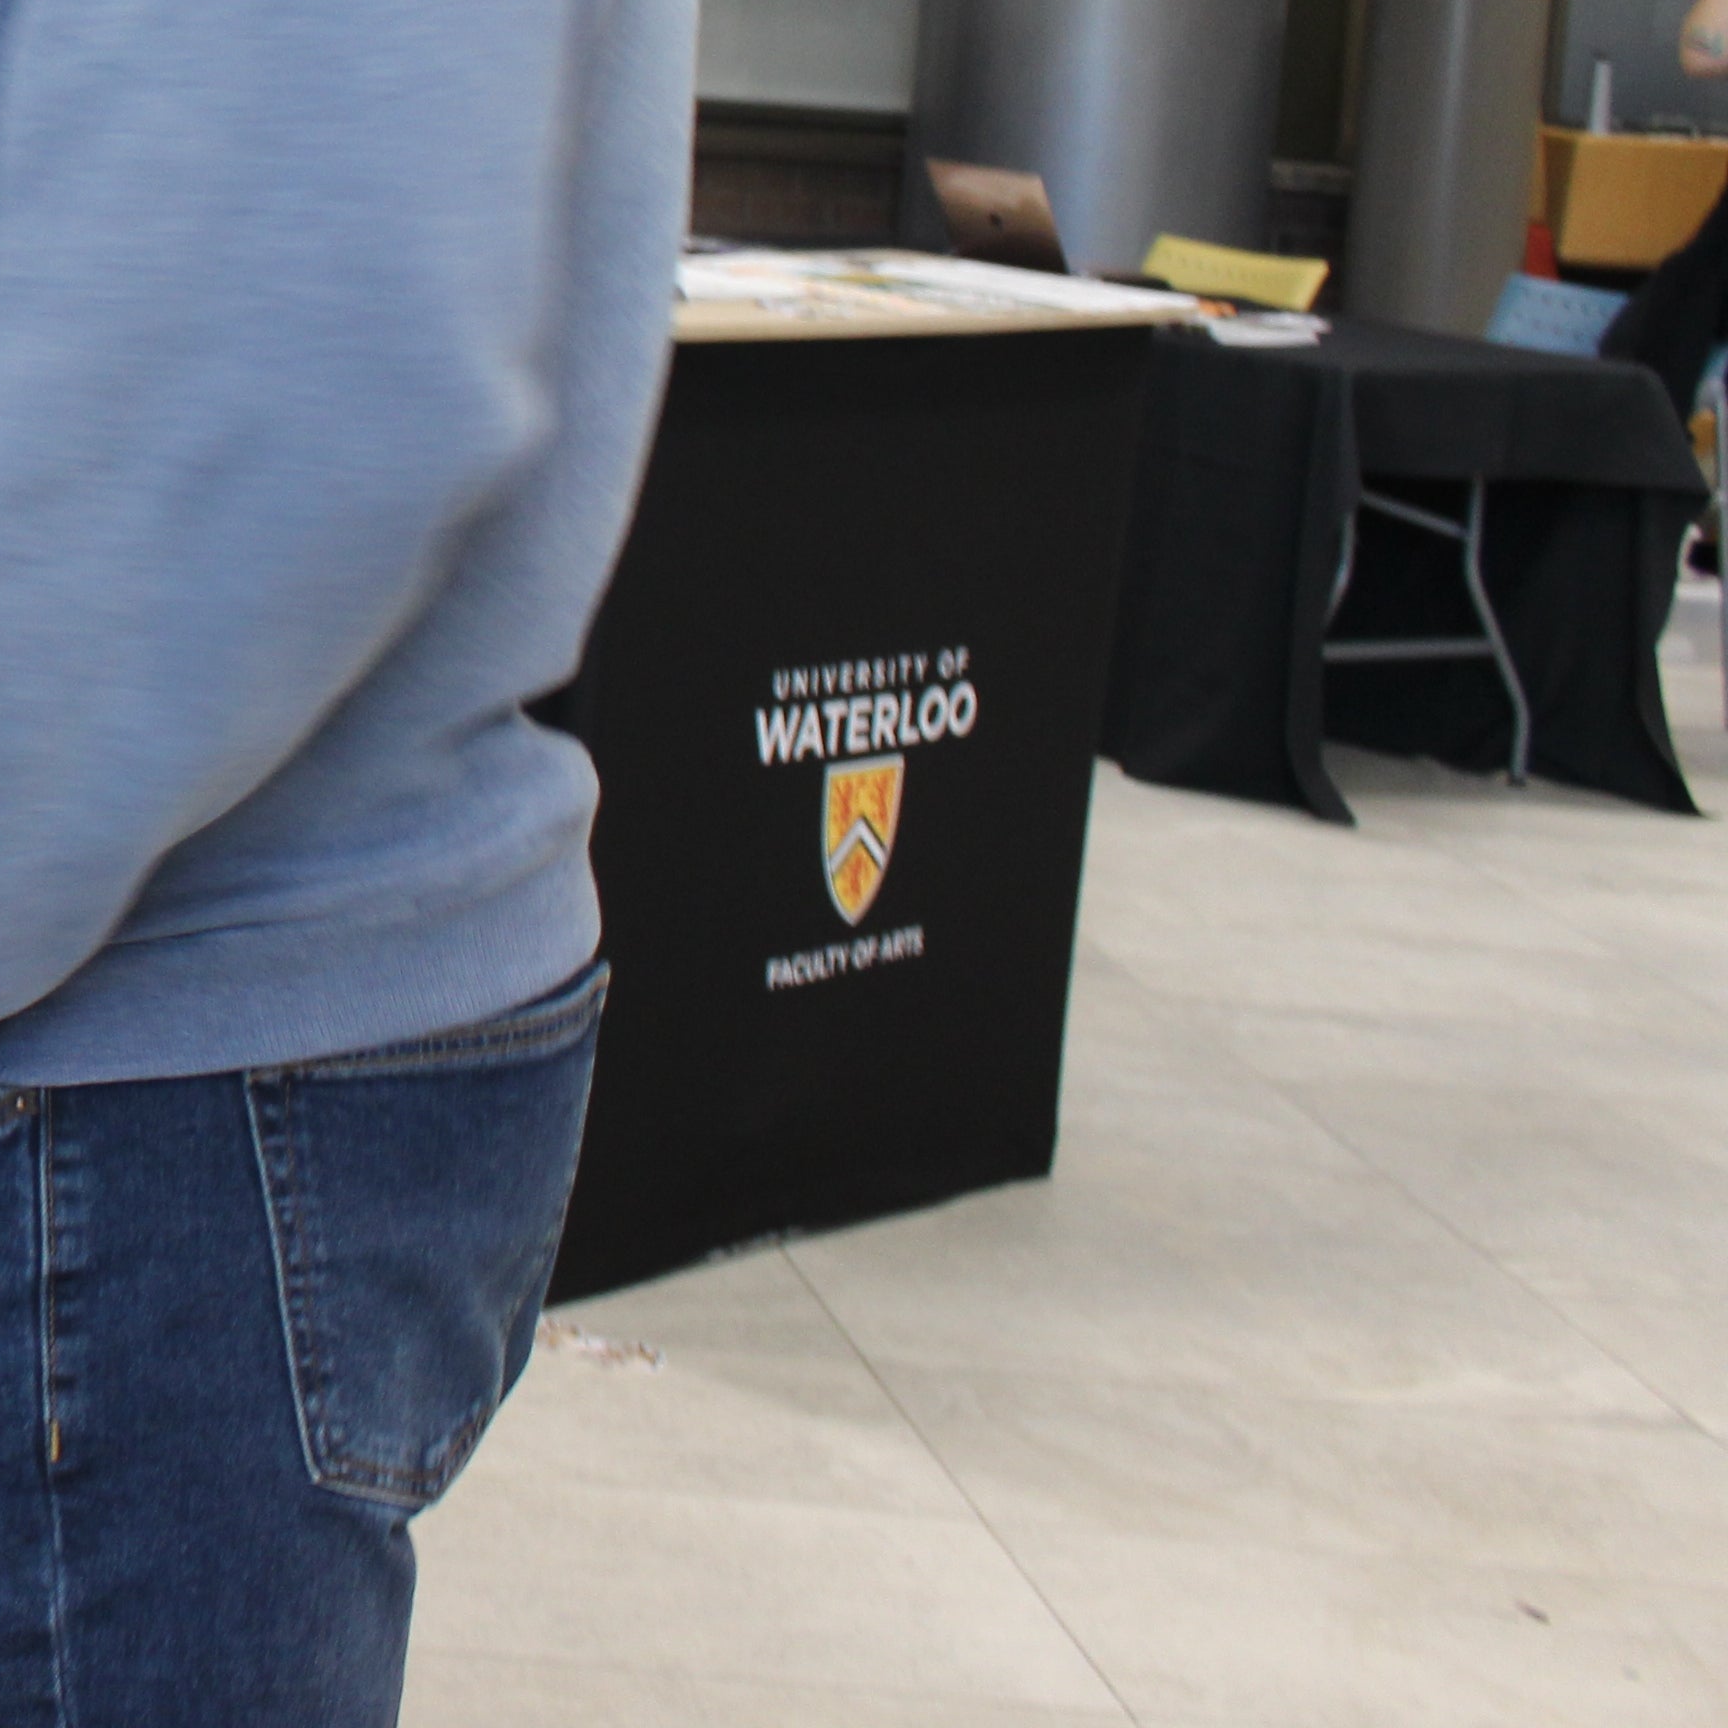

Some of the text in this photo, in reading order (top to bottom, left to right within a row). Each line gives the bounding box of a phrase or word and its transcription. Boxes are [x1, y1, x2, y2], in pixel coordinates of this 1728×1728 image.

[772, 645, 971, 701] UNIVERSITY OF
[755, 679, 978, 766] WATERLOO
[765, 925, 926, 991] FACULTY OF ARTS
